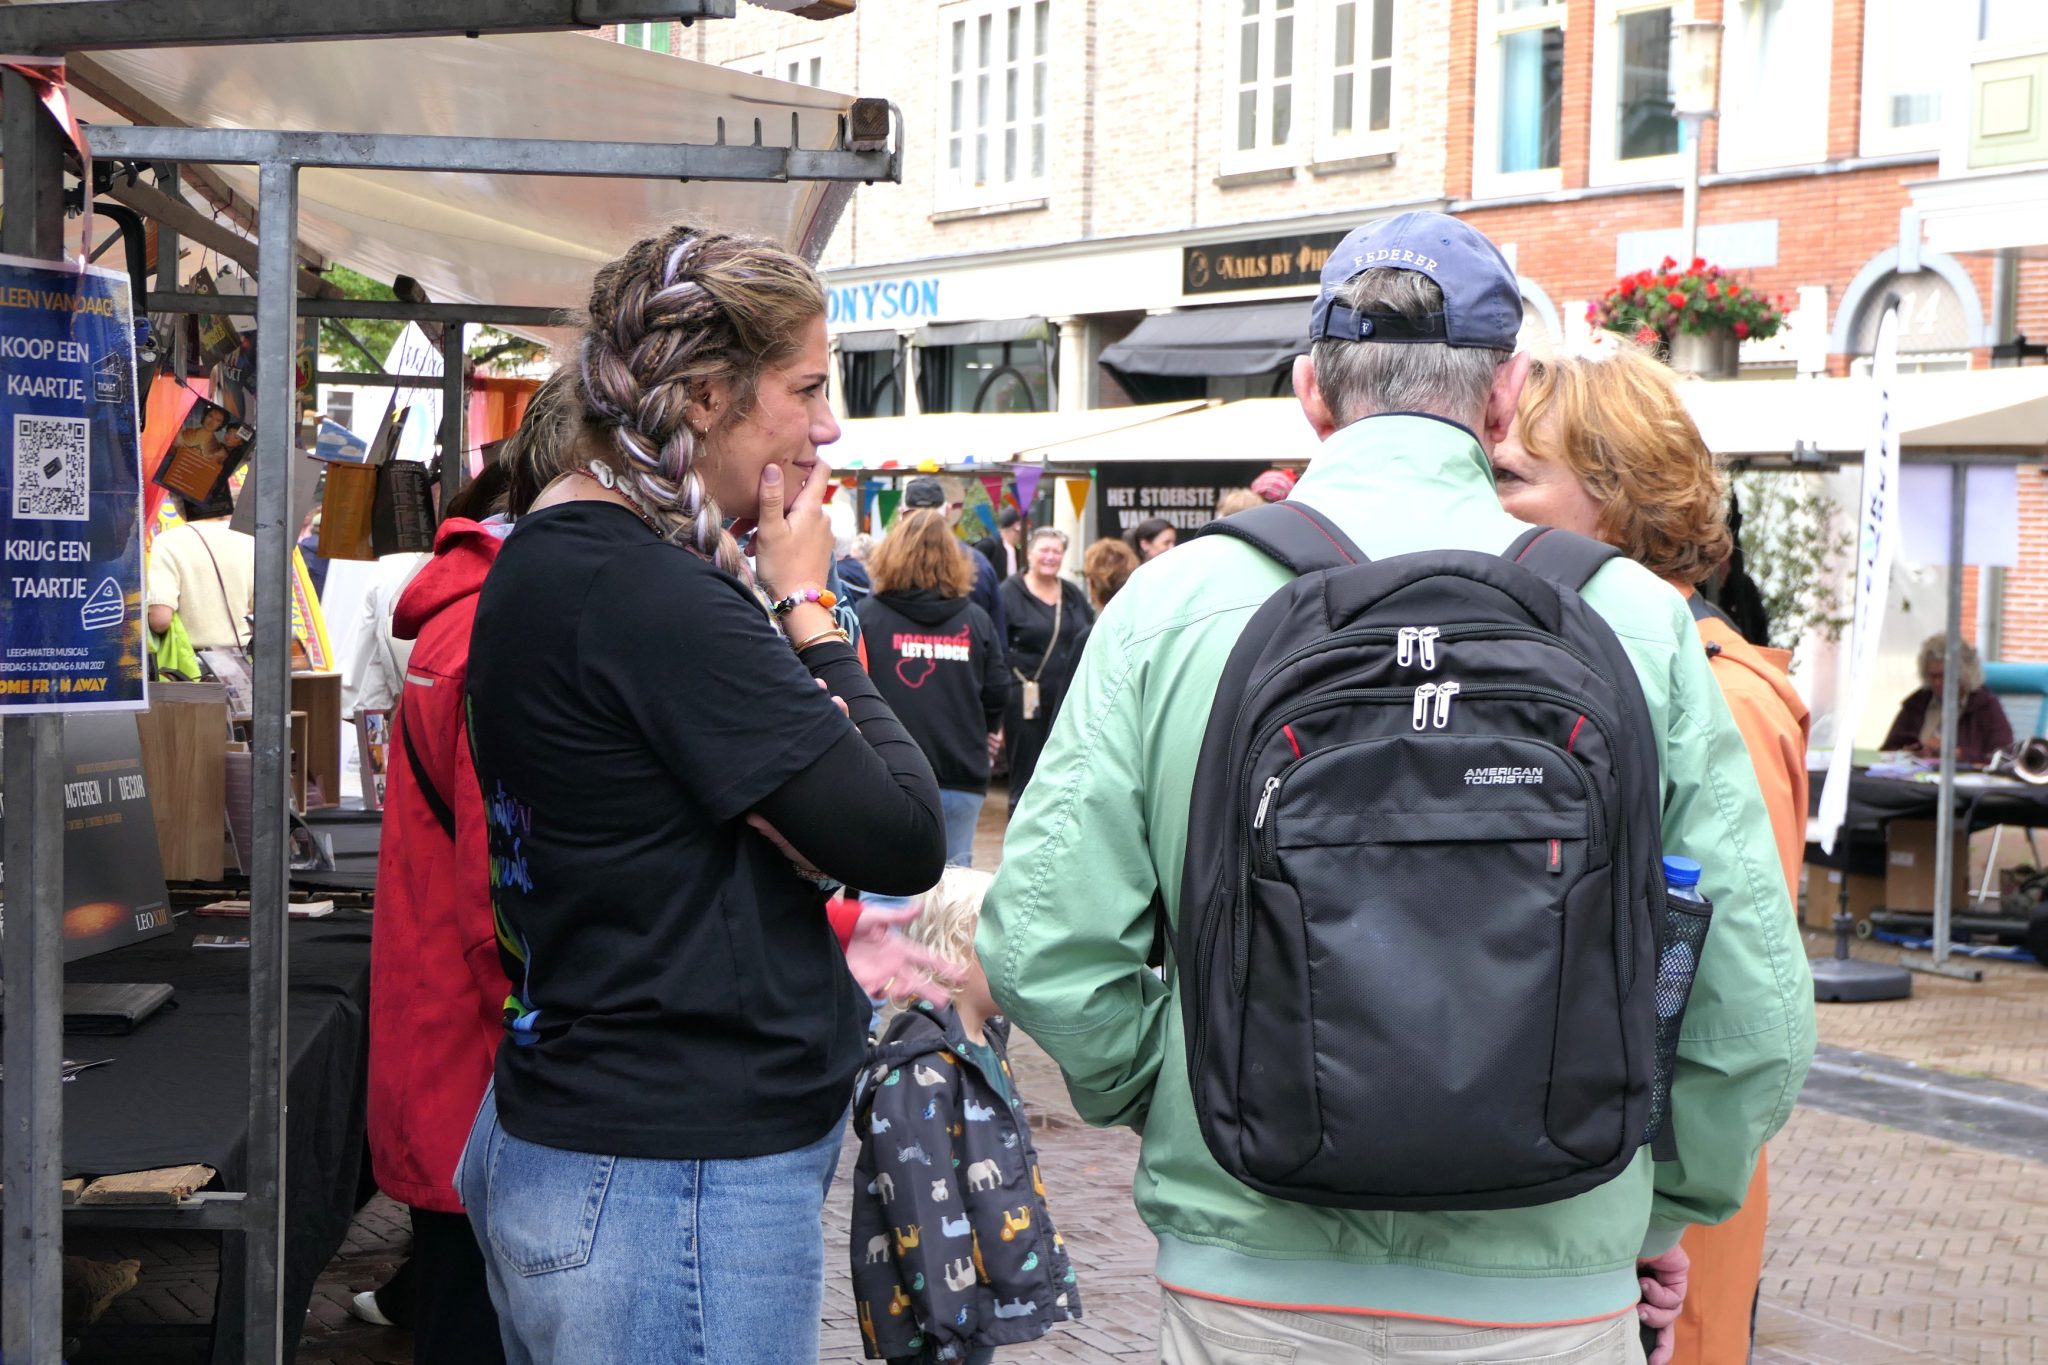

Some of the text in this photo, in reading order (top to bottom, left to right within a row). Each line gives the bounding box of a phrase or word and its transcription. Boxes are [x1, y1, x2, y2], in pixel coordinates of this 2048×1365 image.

[1215, 253, 1267, 279] NAILS
[1271, 253, 1293, 275] BY
[1353, 249, 1438, 273] FEDERER
[1, 336, 89, 363] KOOP EEN
[8, 374, 86, 403] KAARTJE,
[1106, 487, 1136, 507] HET
[1140, 487, 1215, 507] STOERSTE
[5, 540, 91, 562] KRIJG EEN
[12, 577, 87, 599] TAARTJE
[6, 647, 89, 657] LEEGHWATER MUSICALS
[901, 642, 969, 662] LET'S ROCK
[27, 662, 32, 671] 5
[32, 662, 38, 671] &
[38, 661, 69, 671] ZONDAG
[70, 662, 75, 670] 6
[74, 661, 90, 670] JUNI
[72, 677, 108, 692] AWAY
[1464, 767, 1543, 776] AMERICAN
[1464, 776, 1543, 784] TOURISTER
[64, 780, 102, 809] ACTEREN
[118, 774, 146, 800] DECOR
[136, 911, 154, 931] LEO
